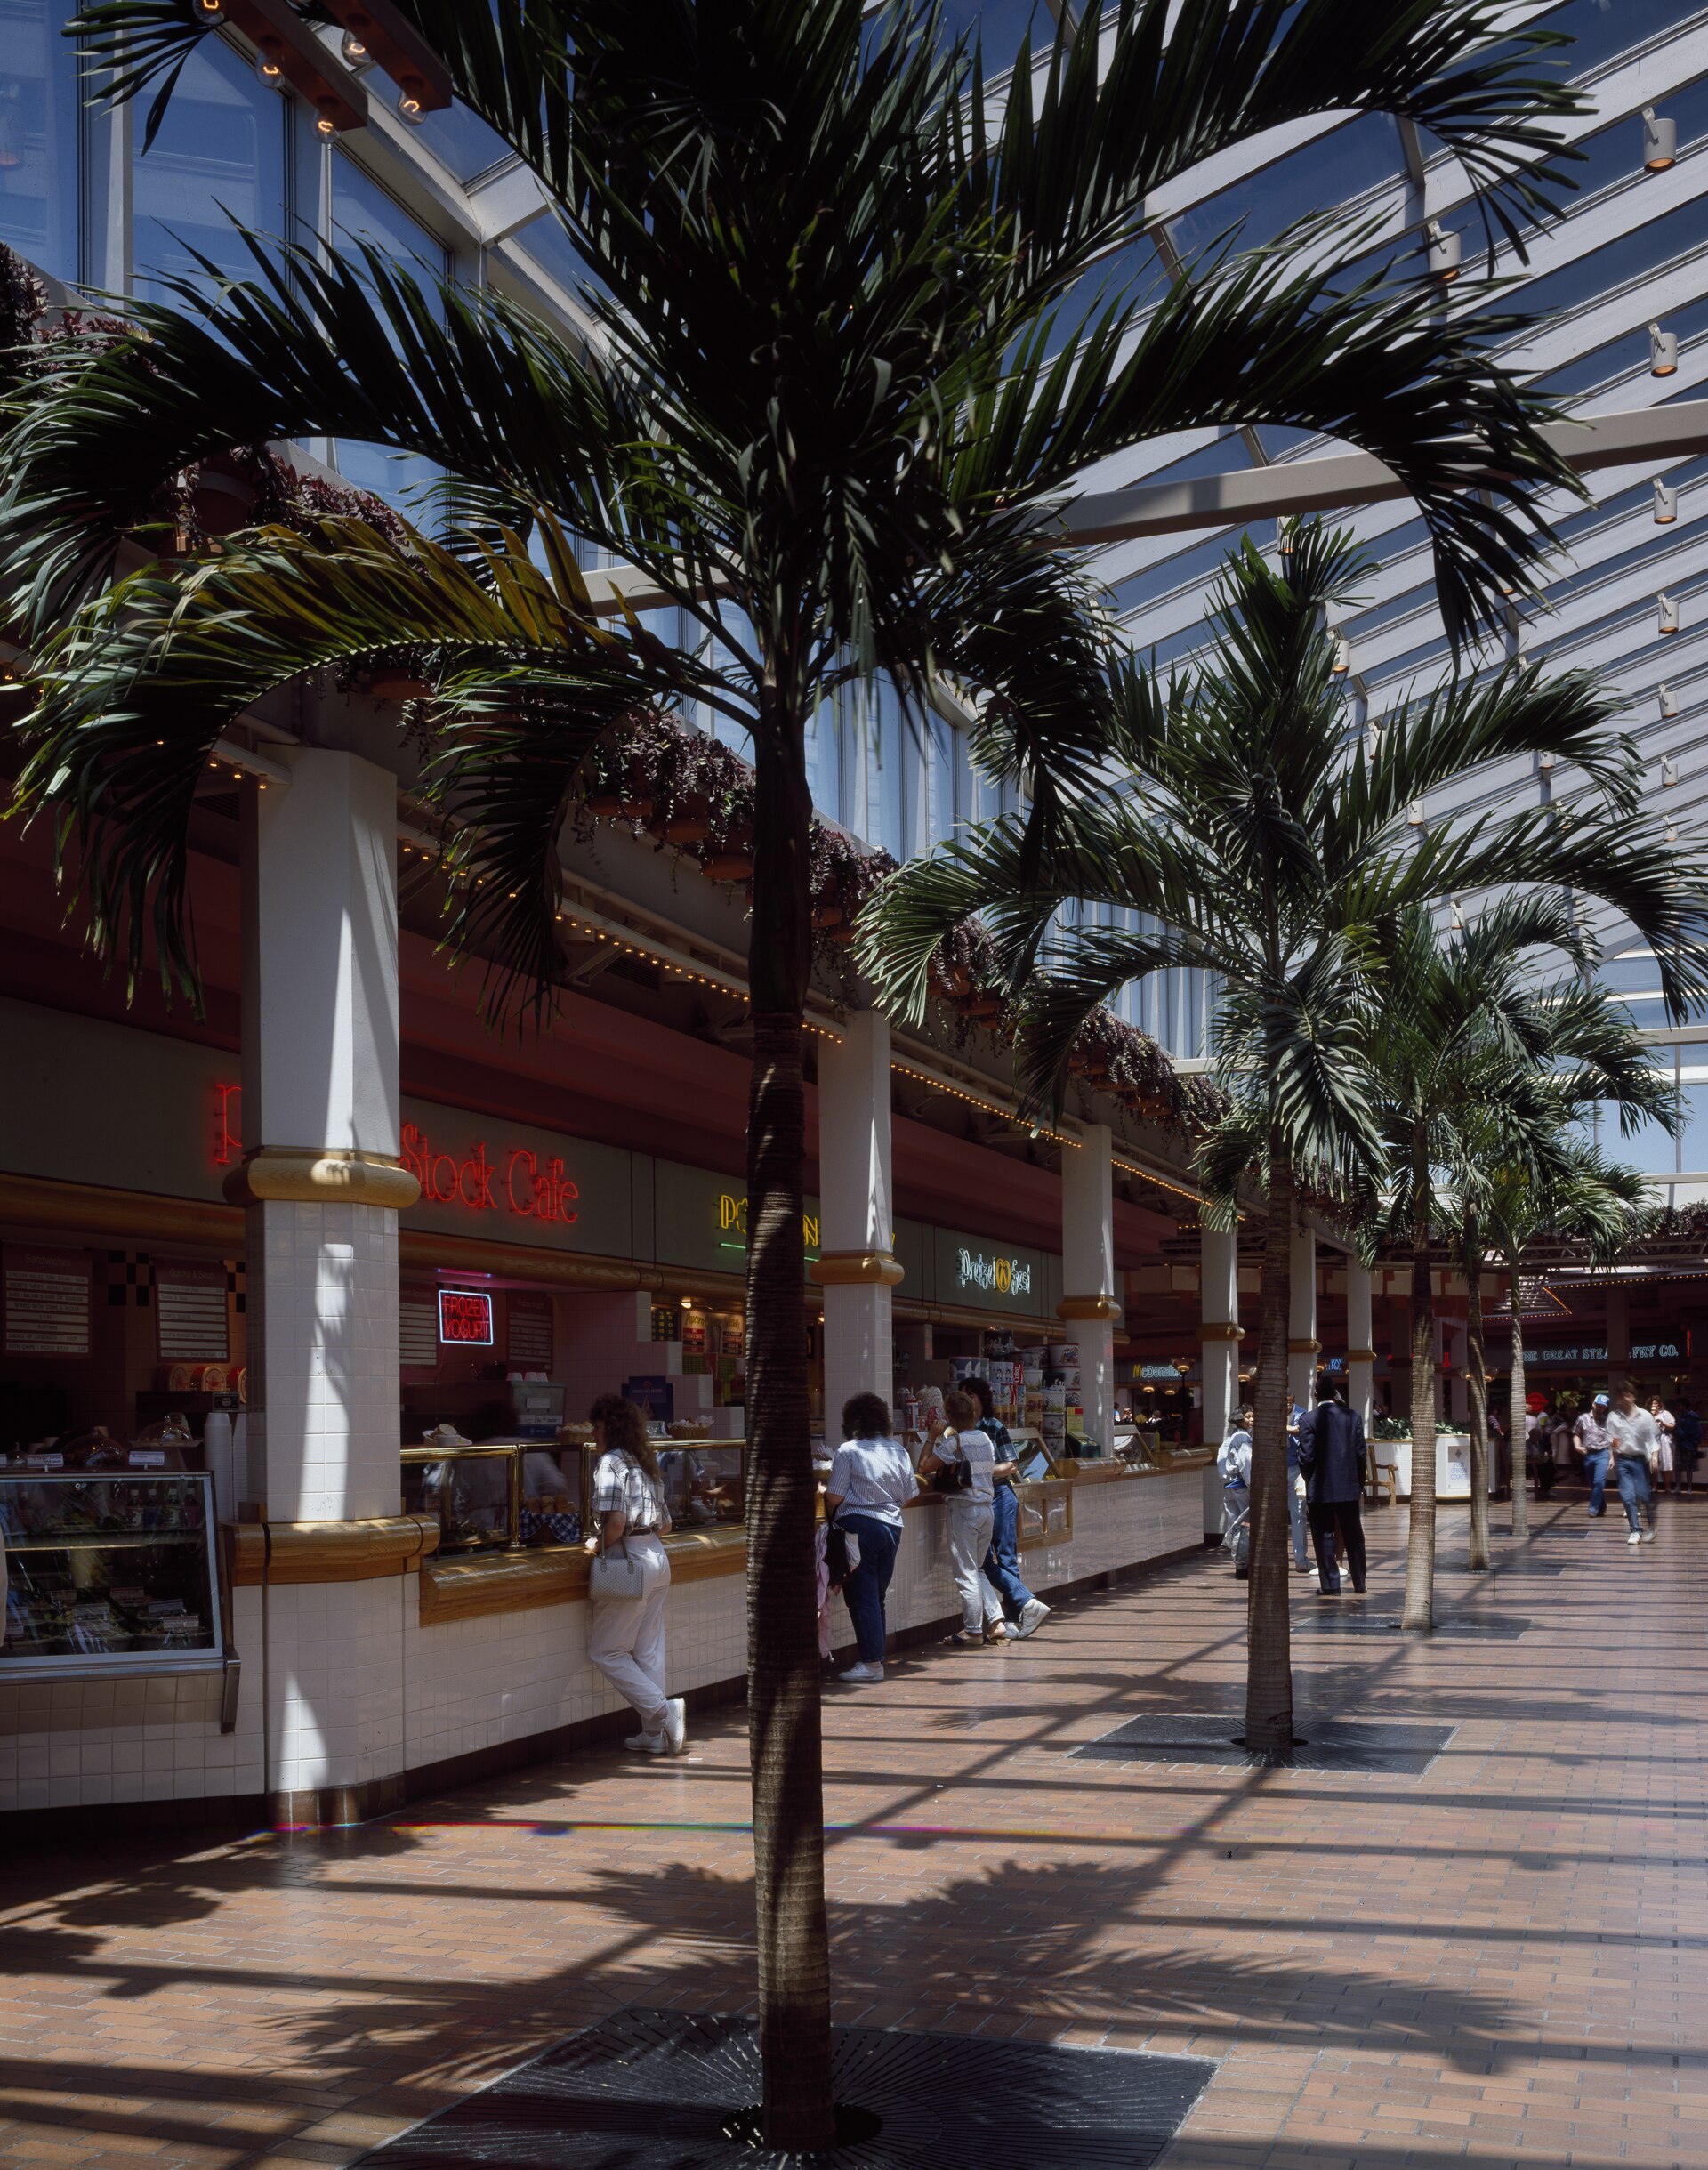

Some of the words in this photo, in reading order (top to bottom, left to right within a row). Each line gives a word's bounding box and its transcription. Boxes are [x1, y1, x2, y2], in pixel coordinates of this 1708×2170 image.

[25, 1253, 71, 1268] Sandwiches
[442, 1295, 488, 1319] FROZEN
[443, 1319, 490, 1339] YOGURT
[1543, 1349, 1578, 1361] GREAT
[1632, 1345, 1656, 1358] FRY
[1659, 1344, 1679, 1357] CO.
